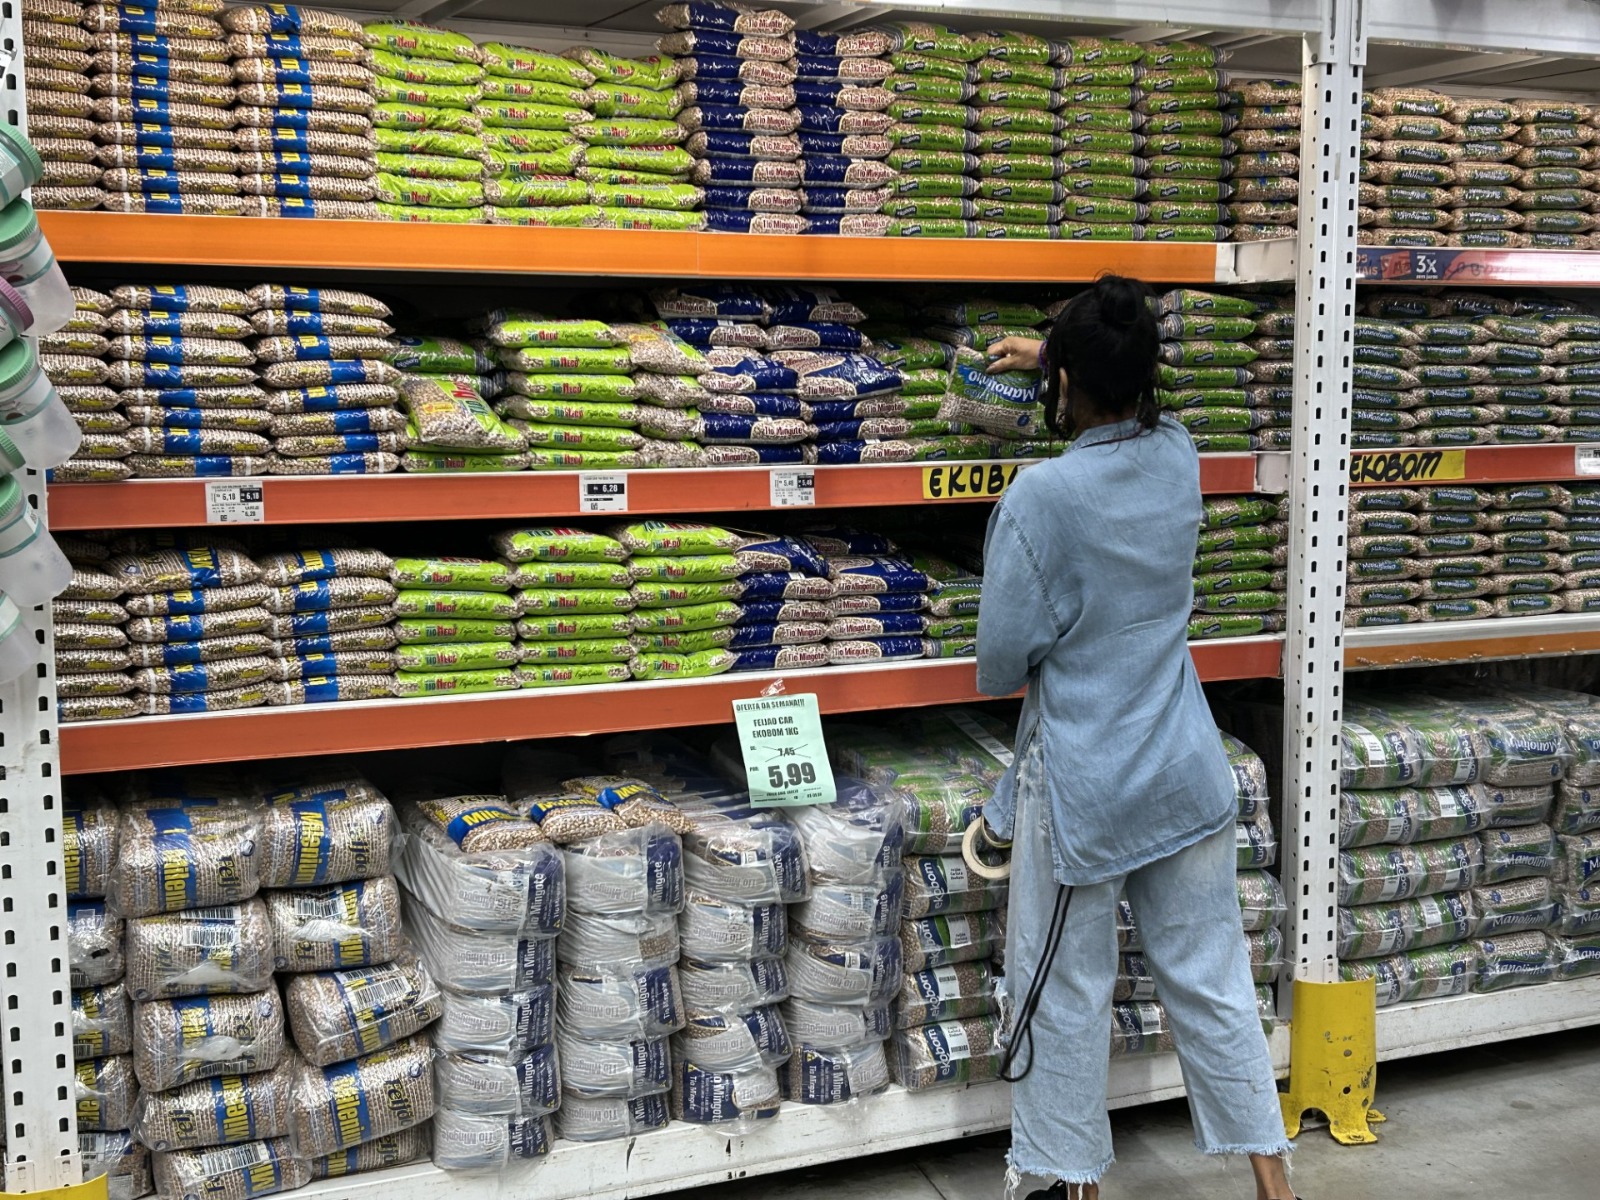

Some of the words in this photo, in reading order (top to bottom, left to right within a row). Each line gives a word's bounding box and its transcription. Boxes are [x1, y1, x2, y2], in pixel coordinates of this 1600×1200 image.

[1416, 255, 1437, 273] 3x
[736, 701, 760, 711] OFERTA
[762, 701, 770, 709] DA
[752, 728, 784, 738] EKOBOM
[785, 727, 798, 735] 1KG
[778, 716, 793, 724] CAR
[768, 762, 816, 789] 5,99
[923, 862, 944, 909] ekobom
[918, 971, 941, 1016] ekobom
[928, 1028, 950, 1075] ekobom
[712, 1085, 724, 1124] Mingote
